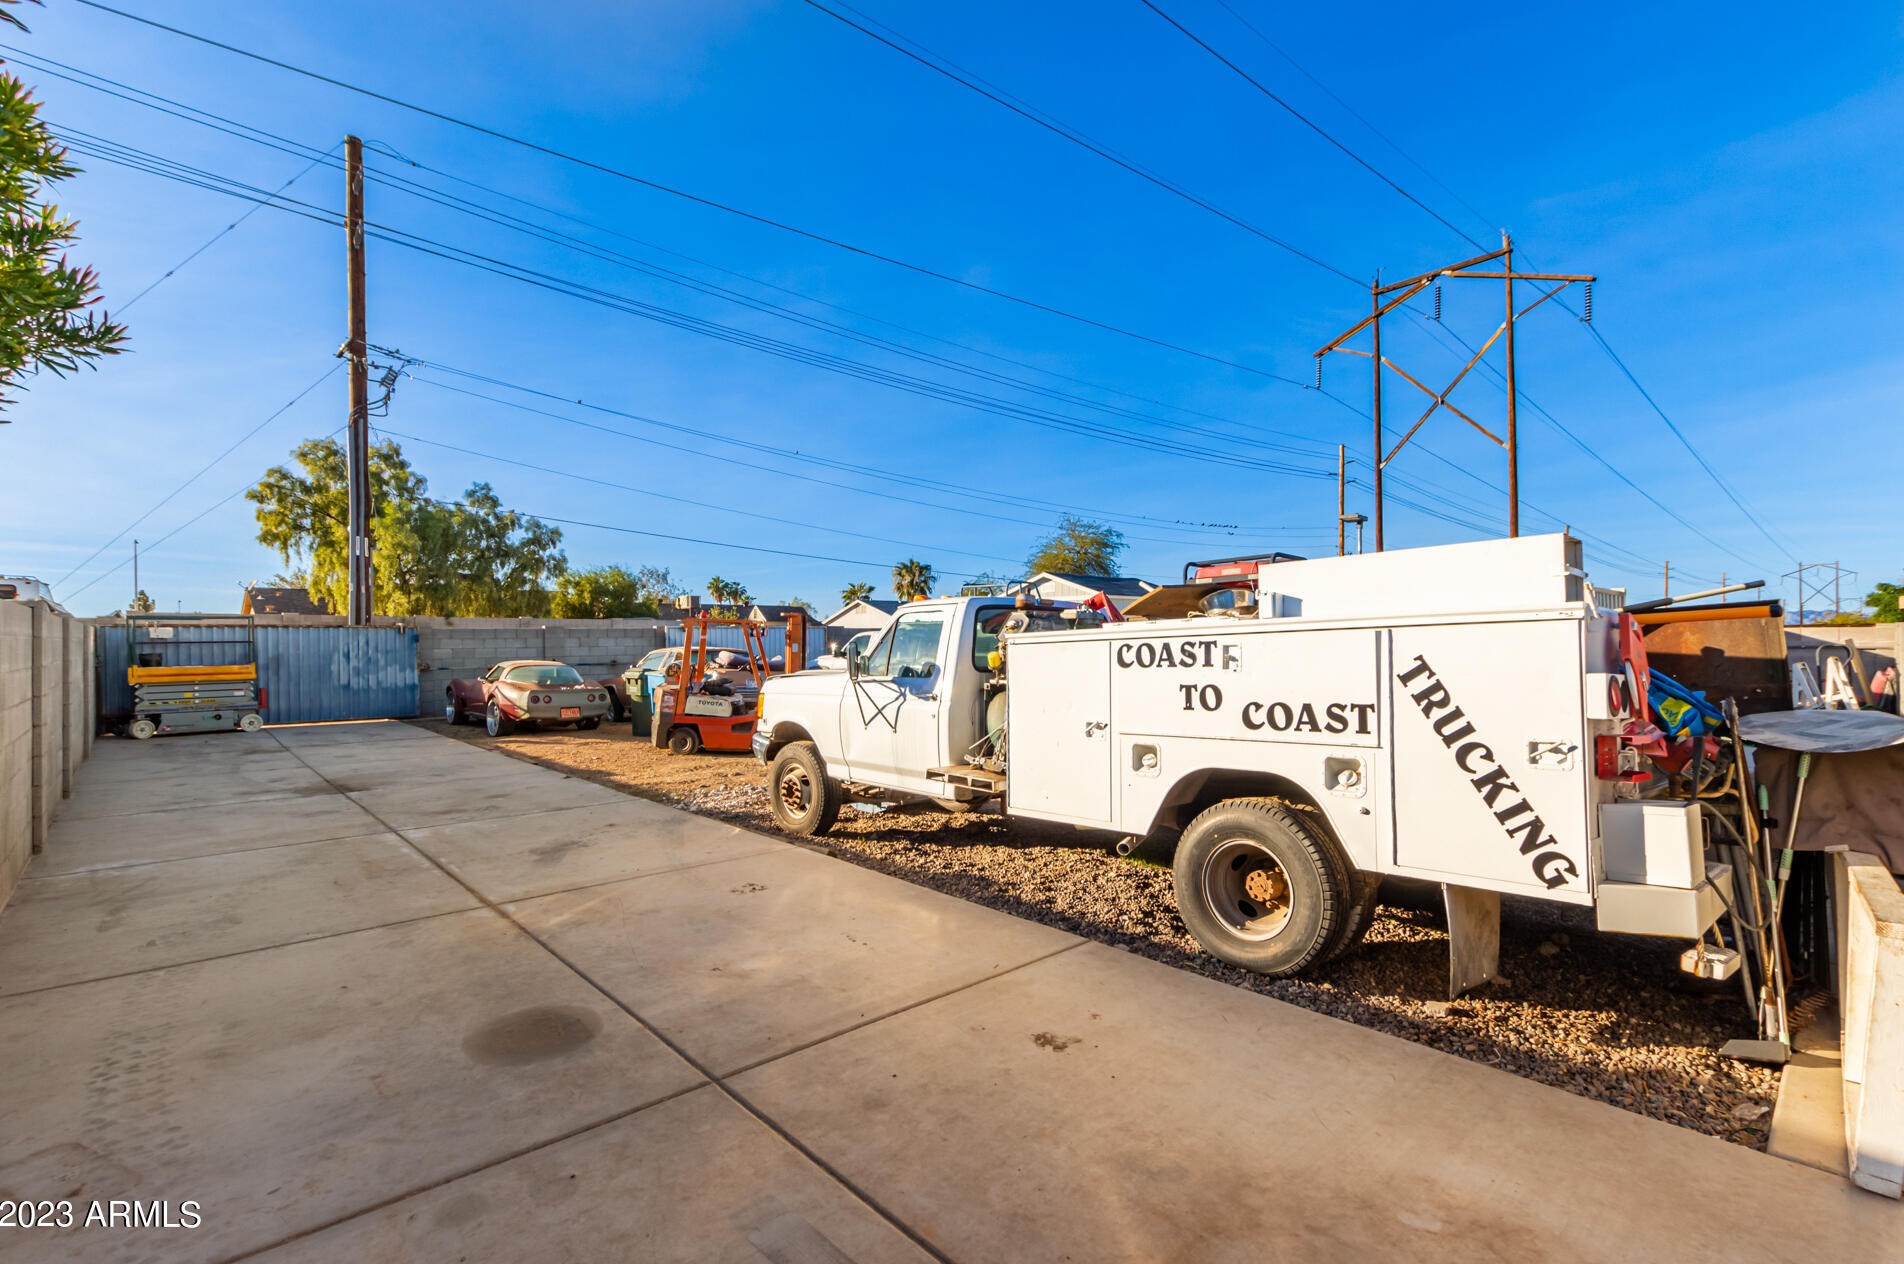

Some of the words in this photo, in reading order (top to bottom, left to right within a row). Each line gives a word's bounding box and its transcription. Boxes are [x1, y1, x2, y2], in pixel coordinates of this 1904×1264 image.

[1117, 640, 1217, 669] COAST
[1179, 683, 1223, 711] TO
[1241, 701, 1375, 735] COAST
[1396, 654, 1579, 890] TRUCKING
